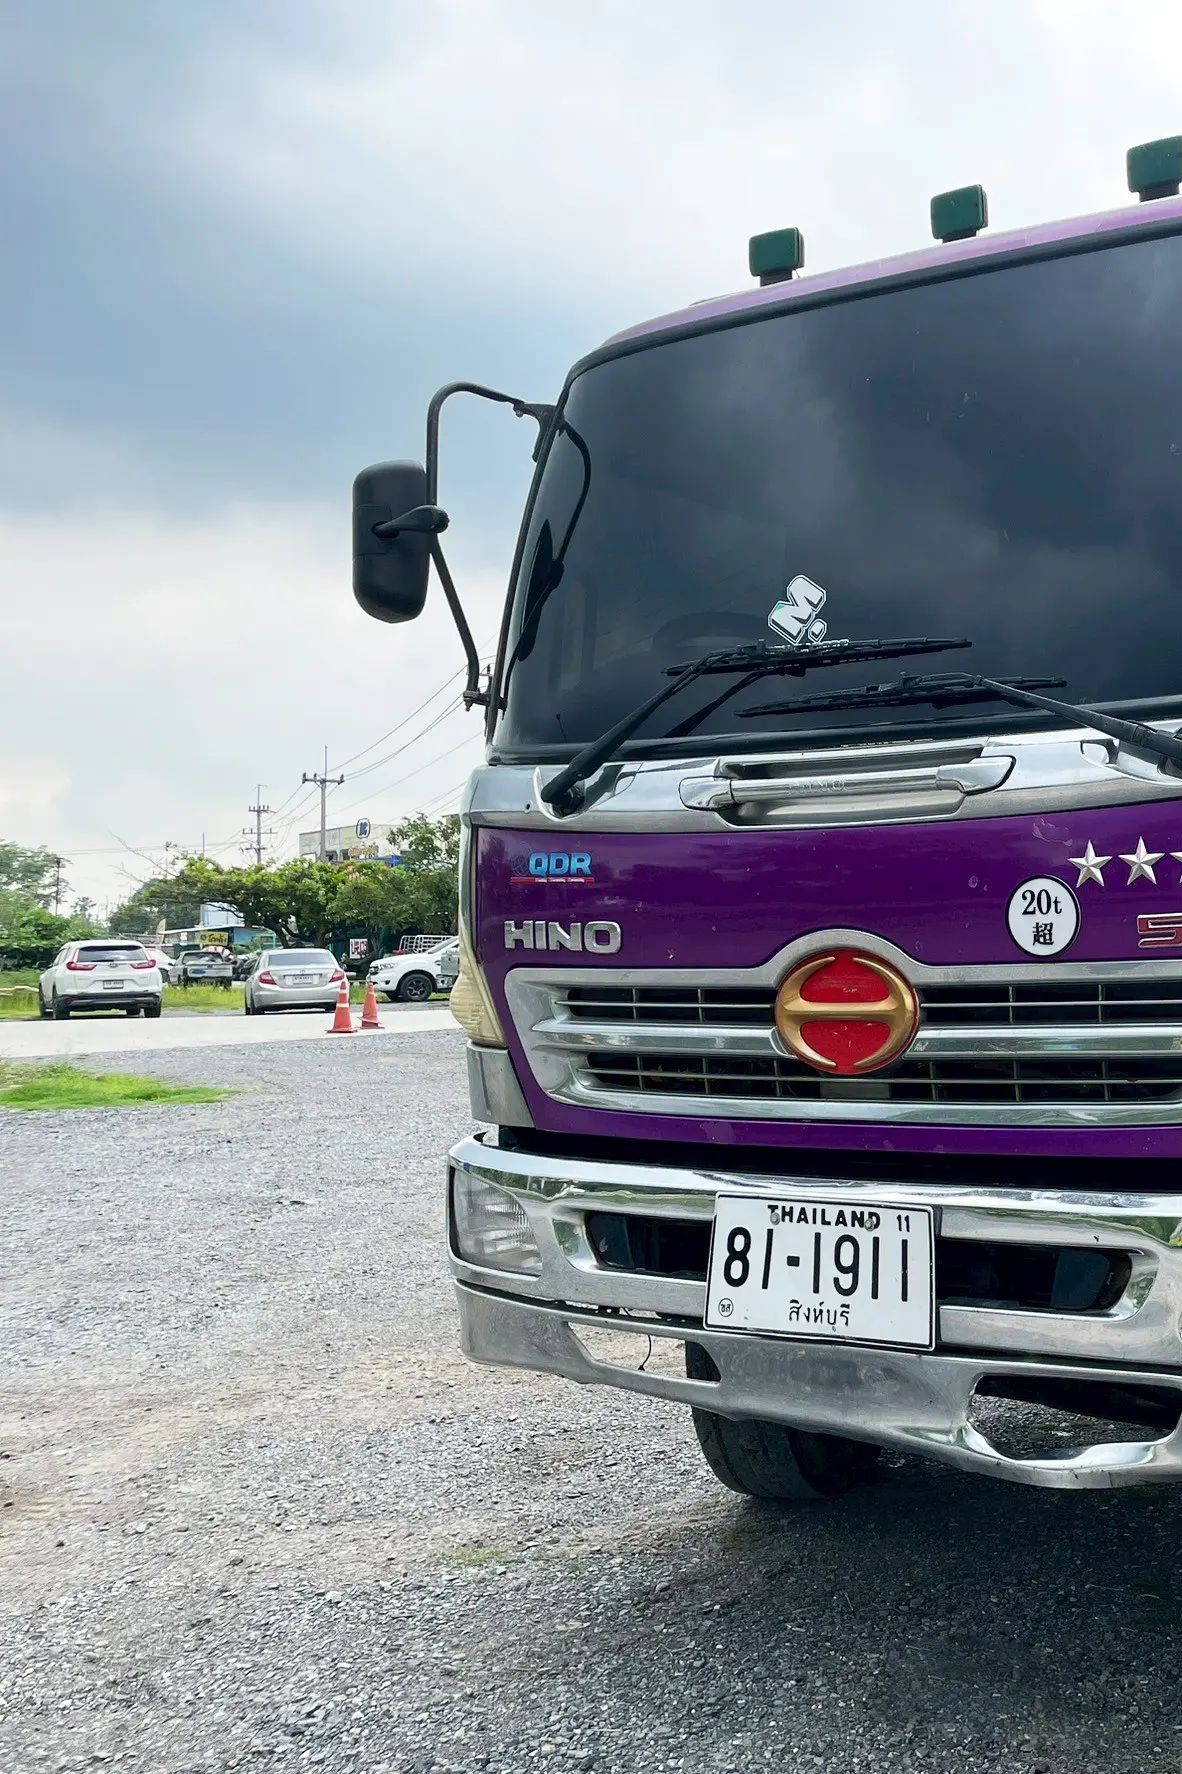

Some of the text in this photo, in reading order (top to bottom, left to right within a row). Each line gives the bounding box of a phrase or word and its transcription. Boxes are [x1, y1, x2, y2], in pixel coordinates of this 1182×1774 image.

[529, 852, 592, 876] QDR
[1021, 888, 1062, 916] 20t
[504, 920, 622, 954] HINO
[1032, 921, 1054, 946] 超
[767, 1204, 911, 1232] THAILAND 11
[723, 1226, 908, 1303] 81-1911
[788, 1299, 851, 1332] สิงห์บุรี
